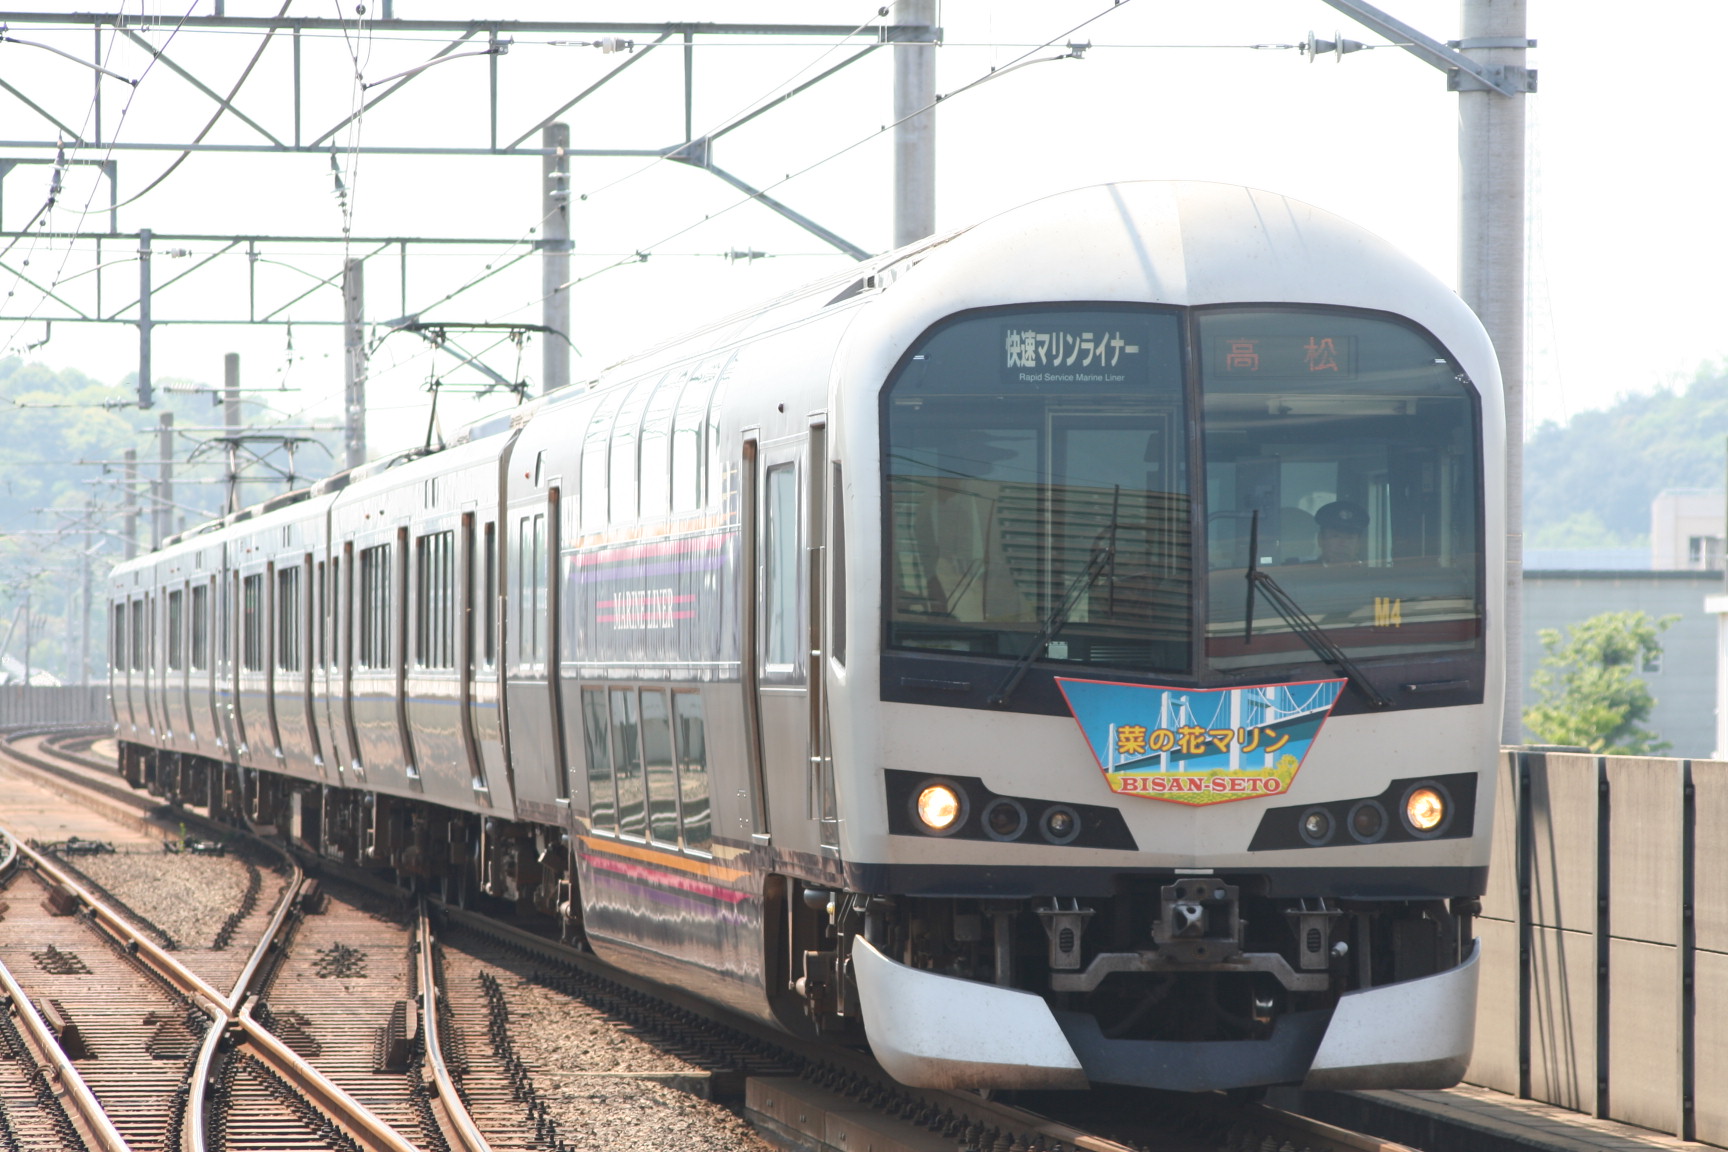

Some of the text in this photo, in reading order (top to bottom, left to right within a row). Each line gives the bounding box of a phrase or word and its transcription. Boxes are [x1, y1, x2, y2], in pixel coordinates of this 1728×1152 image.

[1006, 329, 1139, 368] 快速マリンライナー
[1226, 336, 1339, 372] 高松
[1019, 373, 1125, 382] Rapid Service Marine Liner
[613, 588, 674, 630] MARINE LINER
[1375, 597, 1402, 628] M4
[1117, 725, 1290, 754] 菜の花マリン
[1120, 776, 1281, 793] BISAN-SETO
